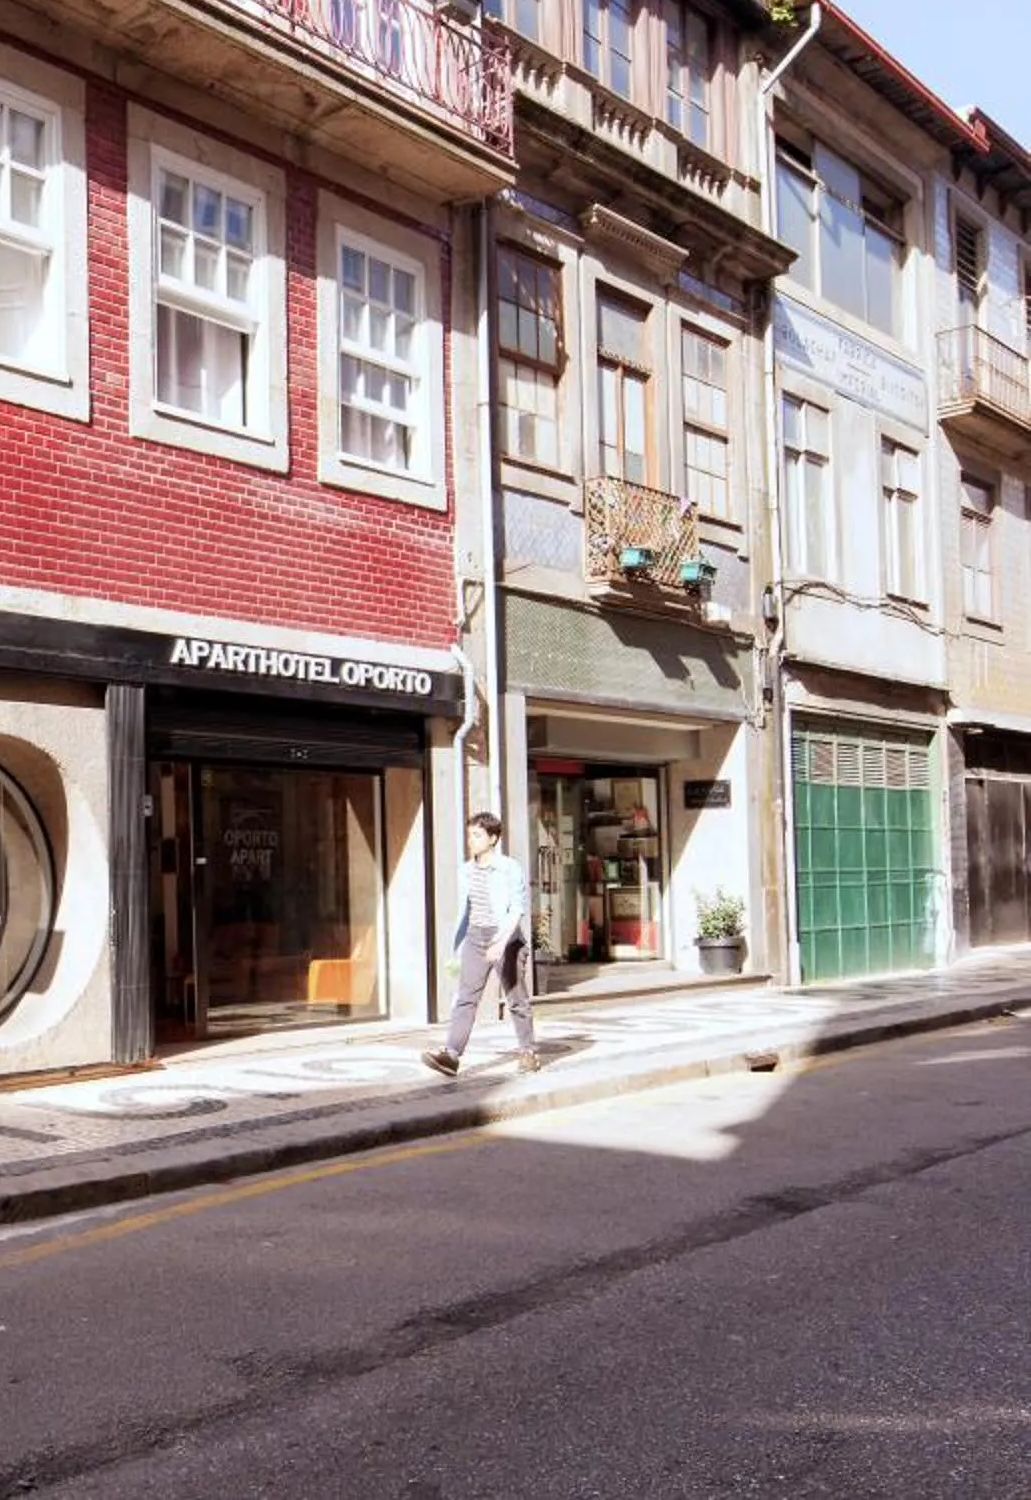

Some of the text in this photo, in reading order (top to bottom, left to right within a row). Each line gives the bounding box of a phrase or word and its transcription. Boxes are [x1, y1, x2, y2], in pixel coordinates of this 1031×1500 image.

[170, 638, 433, 695] APARTHOTEL OPORTO
[223, 830, 278, 846] OPORTO
[230, 848, 274, 865] APART
